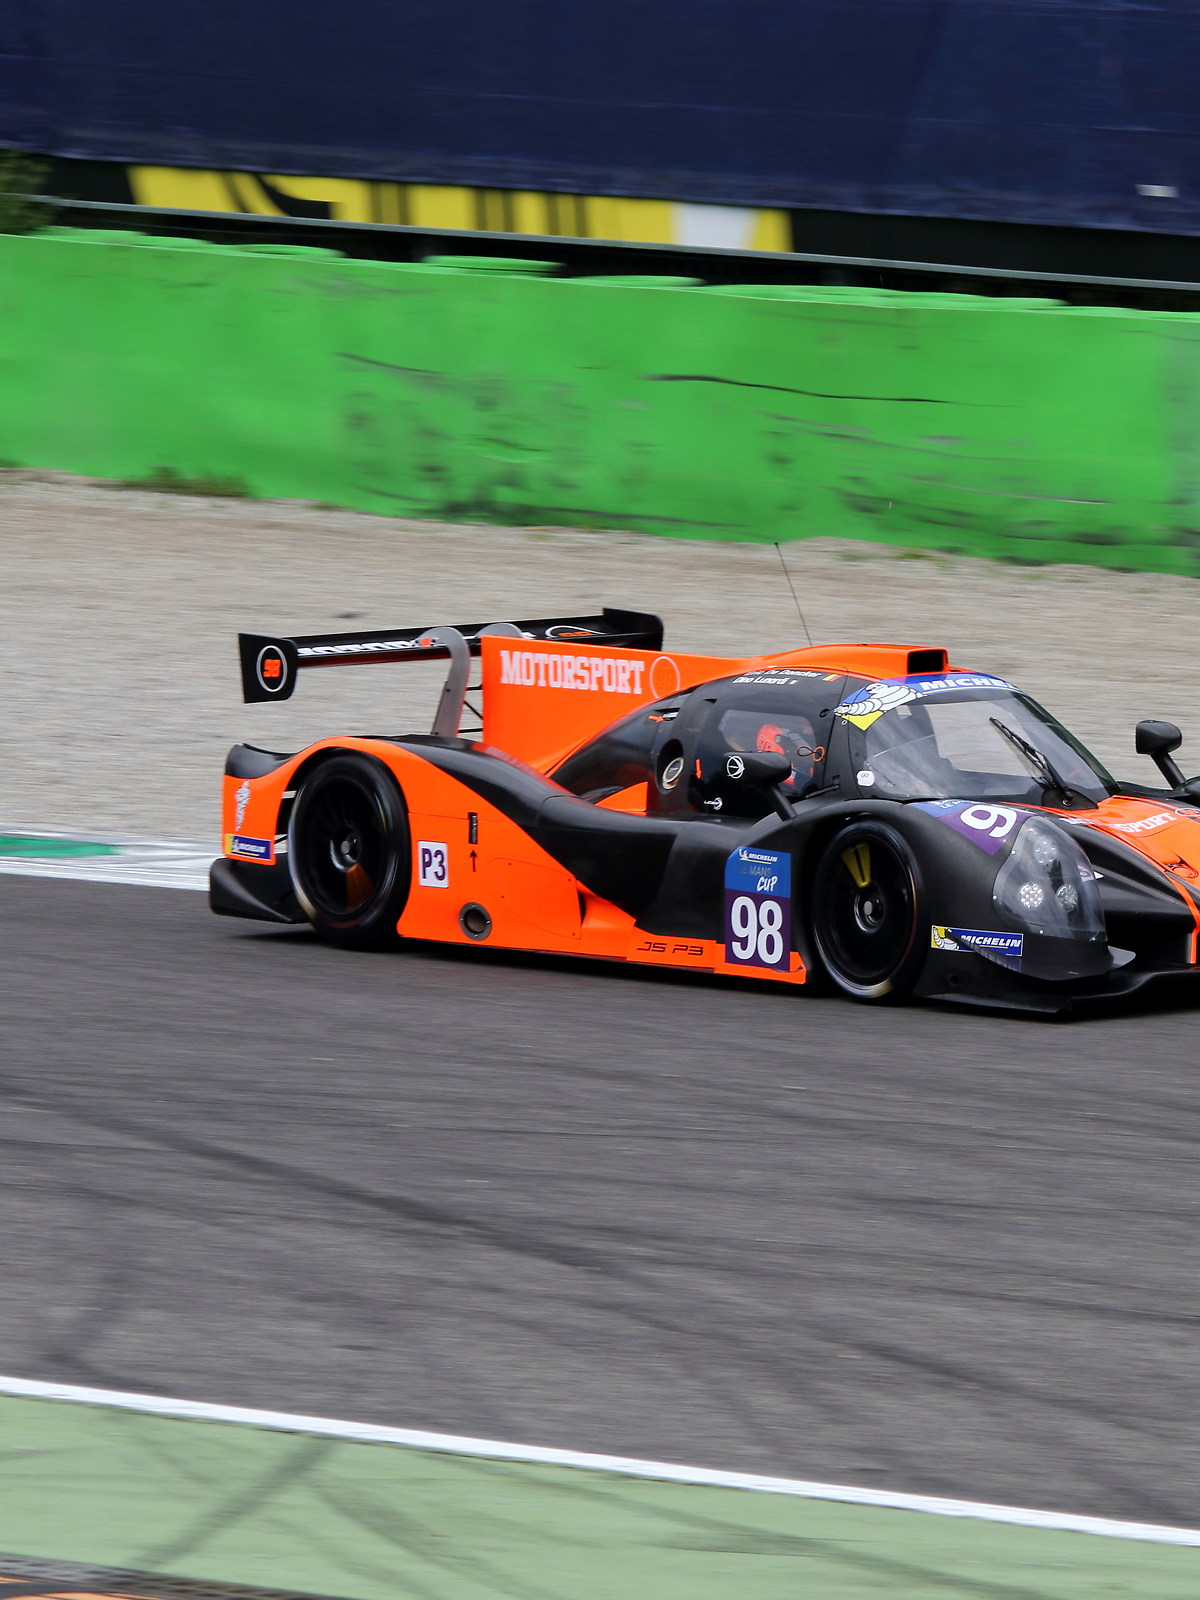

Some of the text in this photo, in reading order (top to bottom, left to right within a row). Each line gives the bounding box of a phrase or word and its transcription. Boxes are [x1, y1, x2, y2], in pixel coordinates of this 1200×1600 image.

[262, 658, 282, 678] 98
[500, 650, 645, 695] MOTORSPORT
[421, 848, 446, 881] P3
[748, 852, 779, 862] MICHELIN
[748, 865, 773, 878] MANS
[756, 875, 778, 892] CUP
[731, 896, 784, 964] 98
[636, 941, 704, 956] JS P3
[960, 934, 1022, 948] MICHELIN
